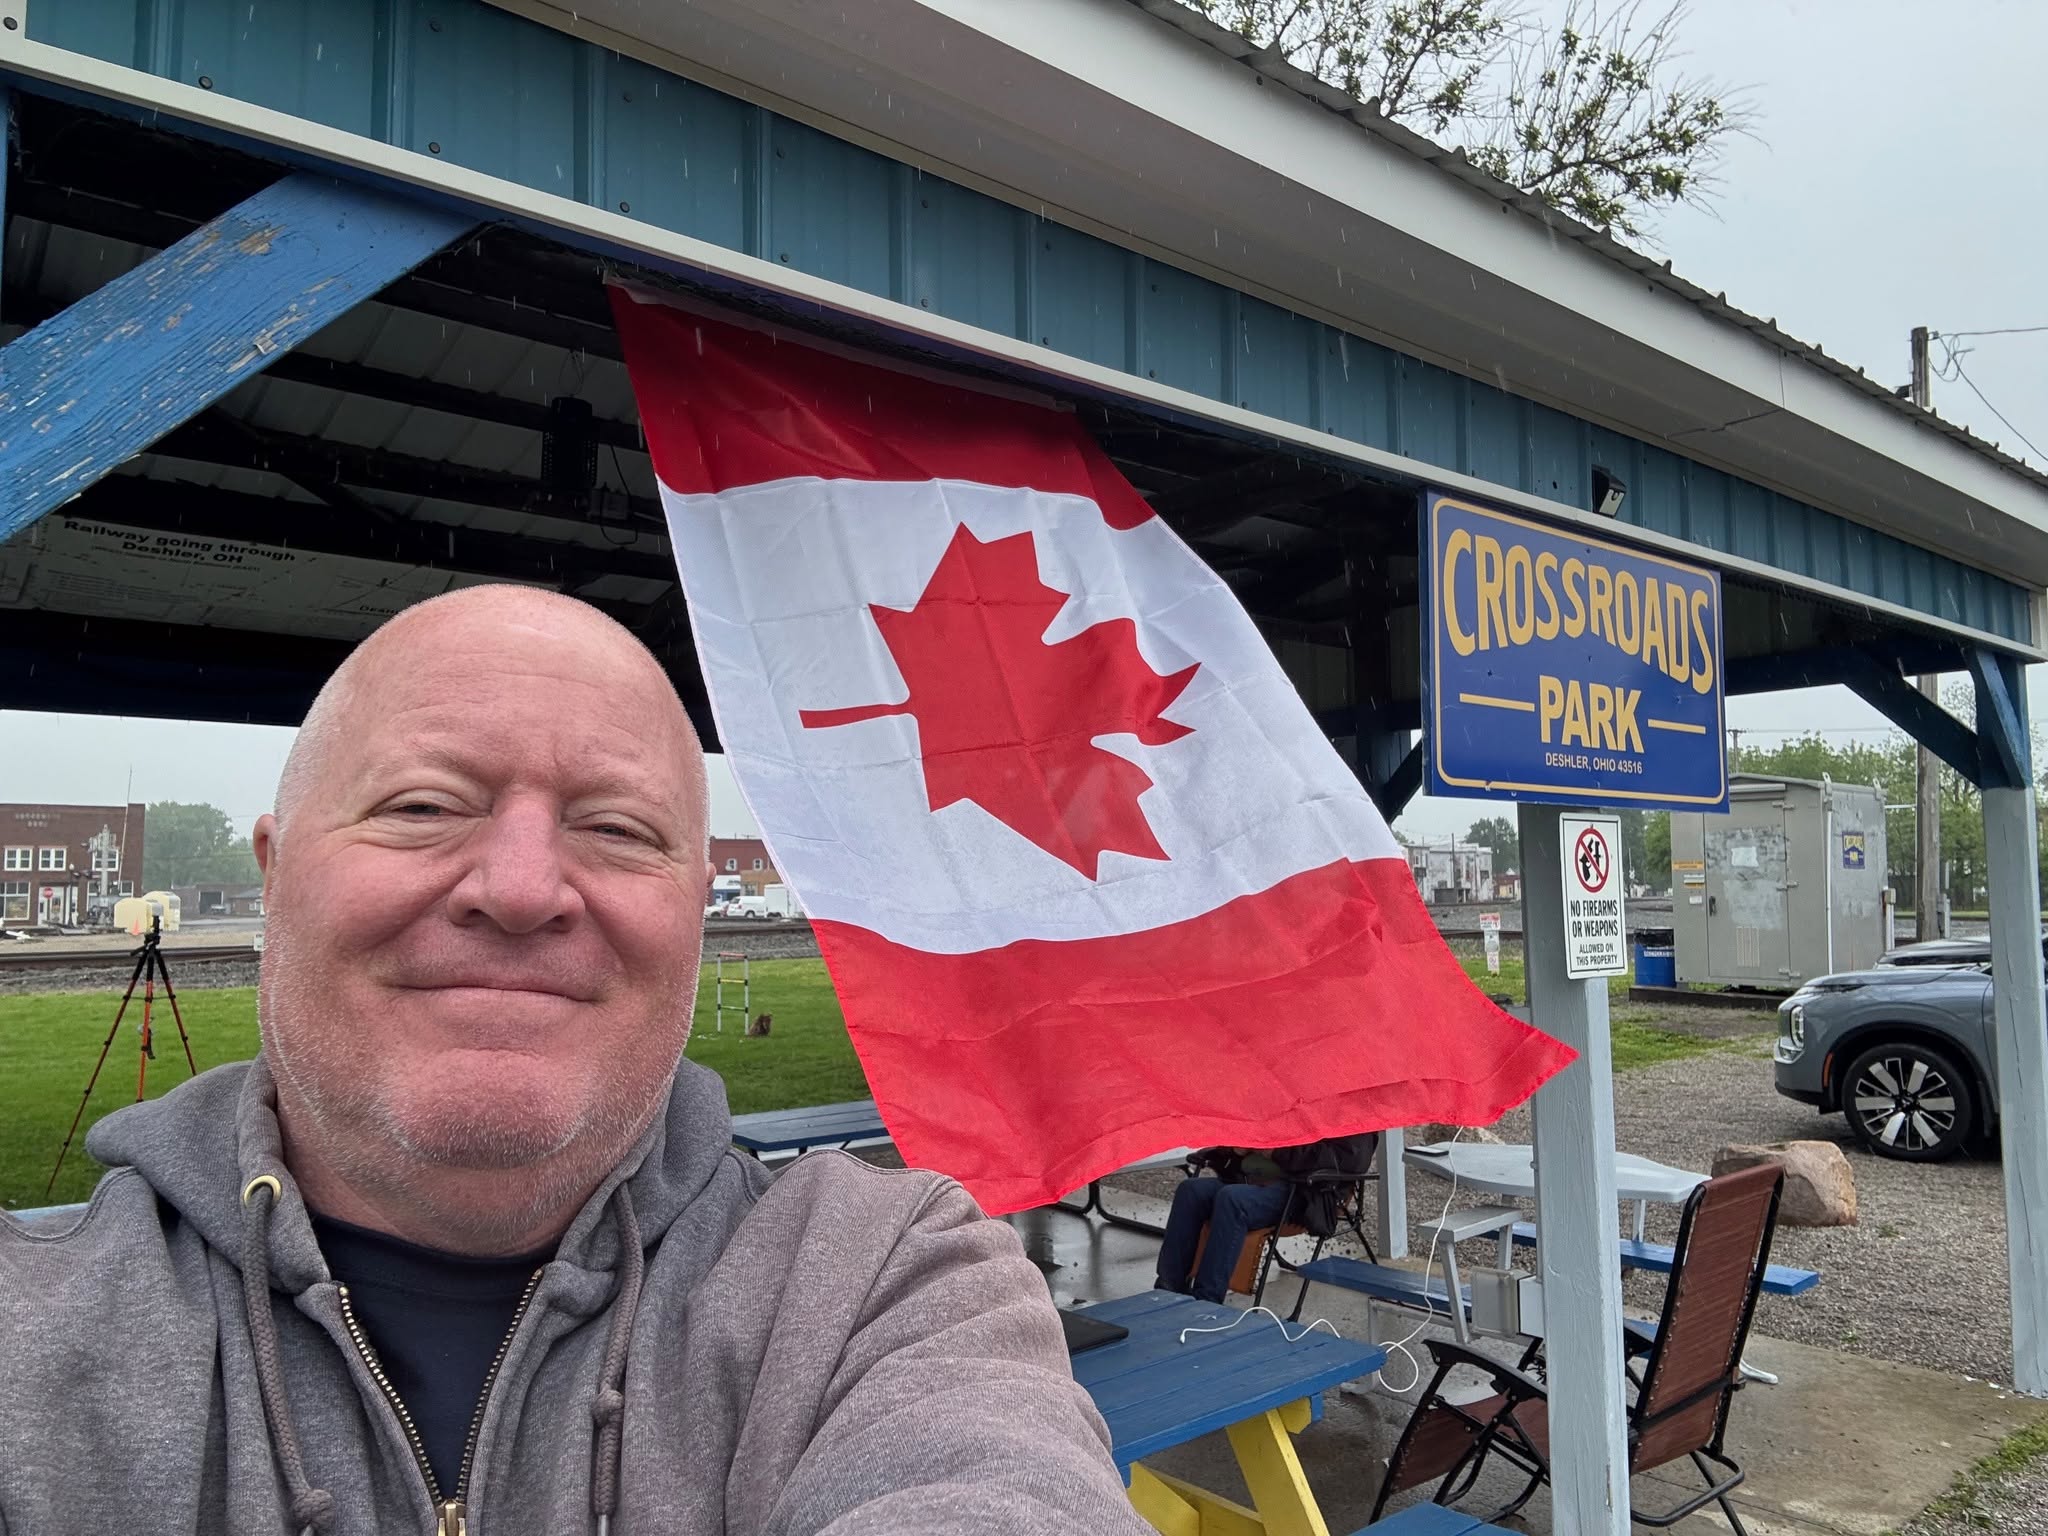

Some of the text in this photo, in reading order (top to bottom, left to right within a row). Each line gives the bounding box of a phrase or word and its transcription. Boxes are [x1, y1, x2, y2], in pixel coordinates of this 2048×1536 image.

[64, 521, 149, 543] Railway
[156, 537, 212, 552] going
[220, 543, 295, 561] through
[122, 541, 205, 561] Deshler,
[213, 553, 243, 563] OH
[1443, 528, 1713, 695] CROSSROADS
[1539, 675, 1645, 753] PARK
[1545, 752, 1643, 774] DESHLER, OHIO 43516
[1570, 900, 1618, 917] NO FIREARMS
[1572, 920, 1619, 938] OR WEAPONS
[1579, 943, 1614, 954] ALLOWED ON
[1576, 954, 1618, 966] THIS PROPERTY
